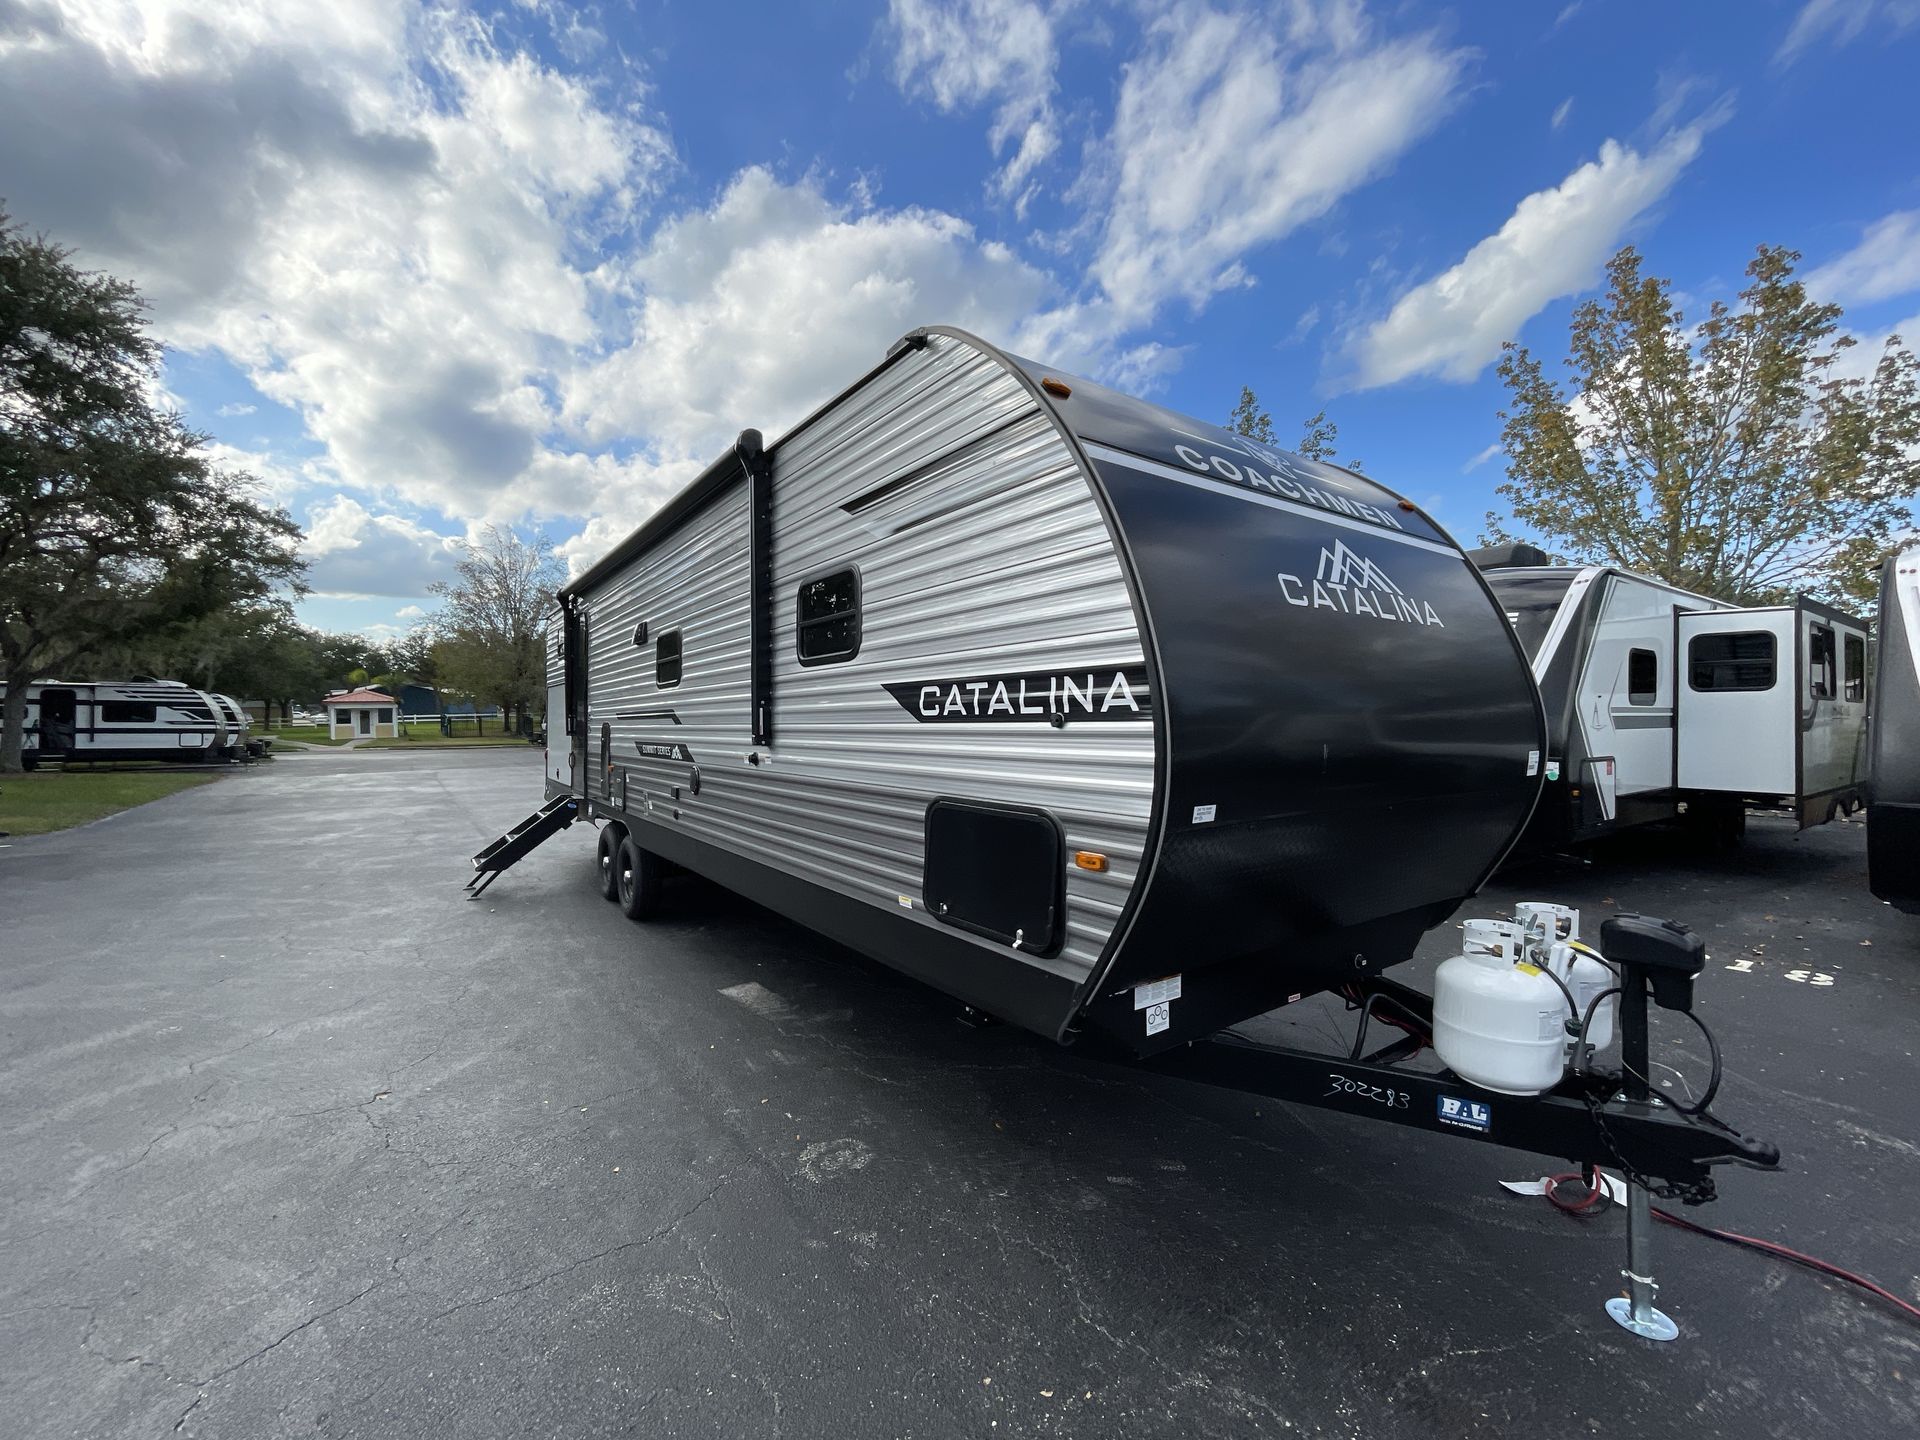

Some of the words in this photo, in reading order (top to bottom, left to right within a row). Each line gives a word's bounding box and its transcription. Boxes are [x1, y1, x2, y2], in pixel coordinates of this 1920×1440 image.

[1174, 444, 1403, 529] COACHMEN
[1277, 572, 1445, 628] CATALINA
[919, 671, 1140, 716] CATALINA
[657, 746, 671, 756] SERIES
[1323, 1074, 1410, 1109] 302283
